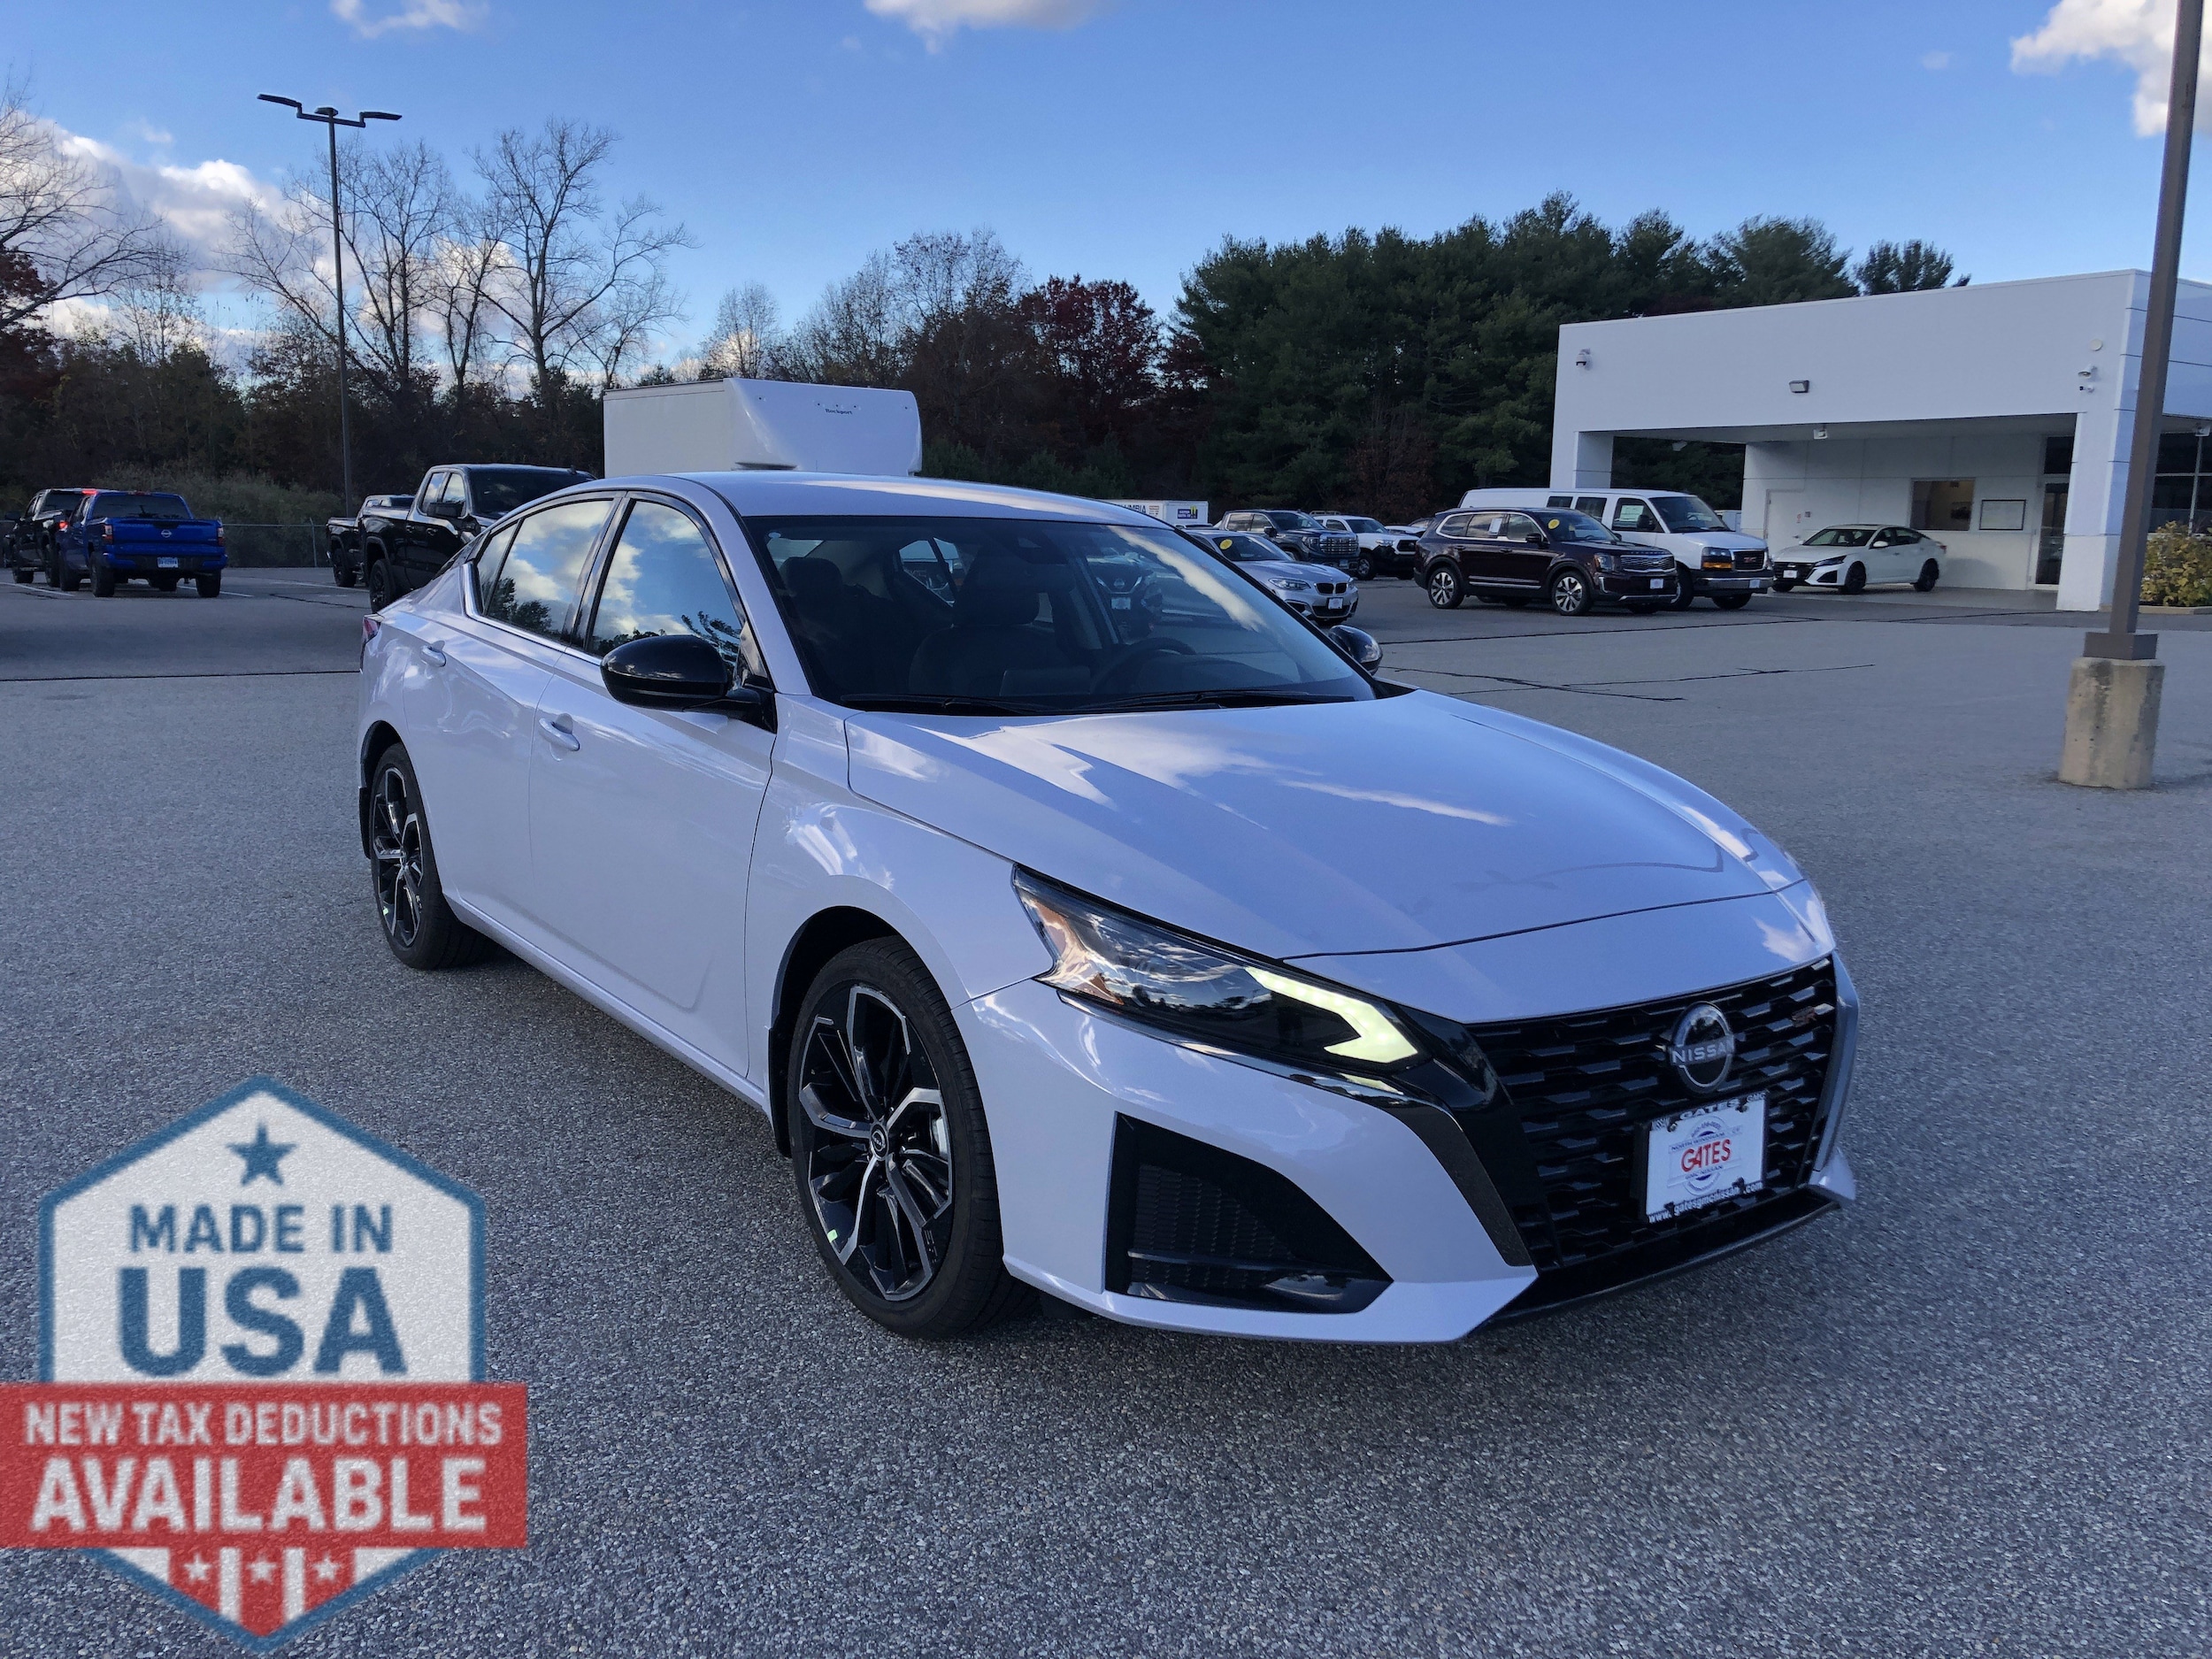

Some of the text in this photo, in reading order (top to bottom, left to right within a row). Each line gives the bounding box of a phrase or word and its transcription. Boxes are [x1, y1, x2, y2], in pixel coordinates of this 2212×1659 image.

[1671, 1039, 1734, 1064] NISSAN
[1680, 1098, 1740, 1120] GATES
[1680, 1139, 1732, 1172] GATES
